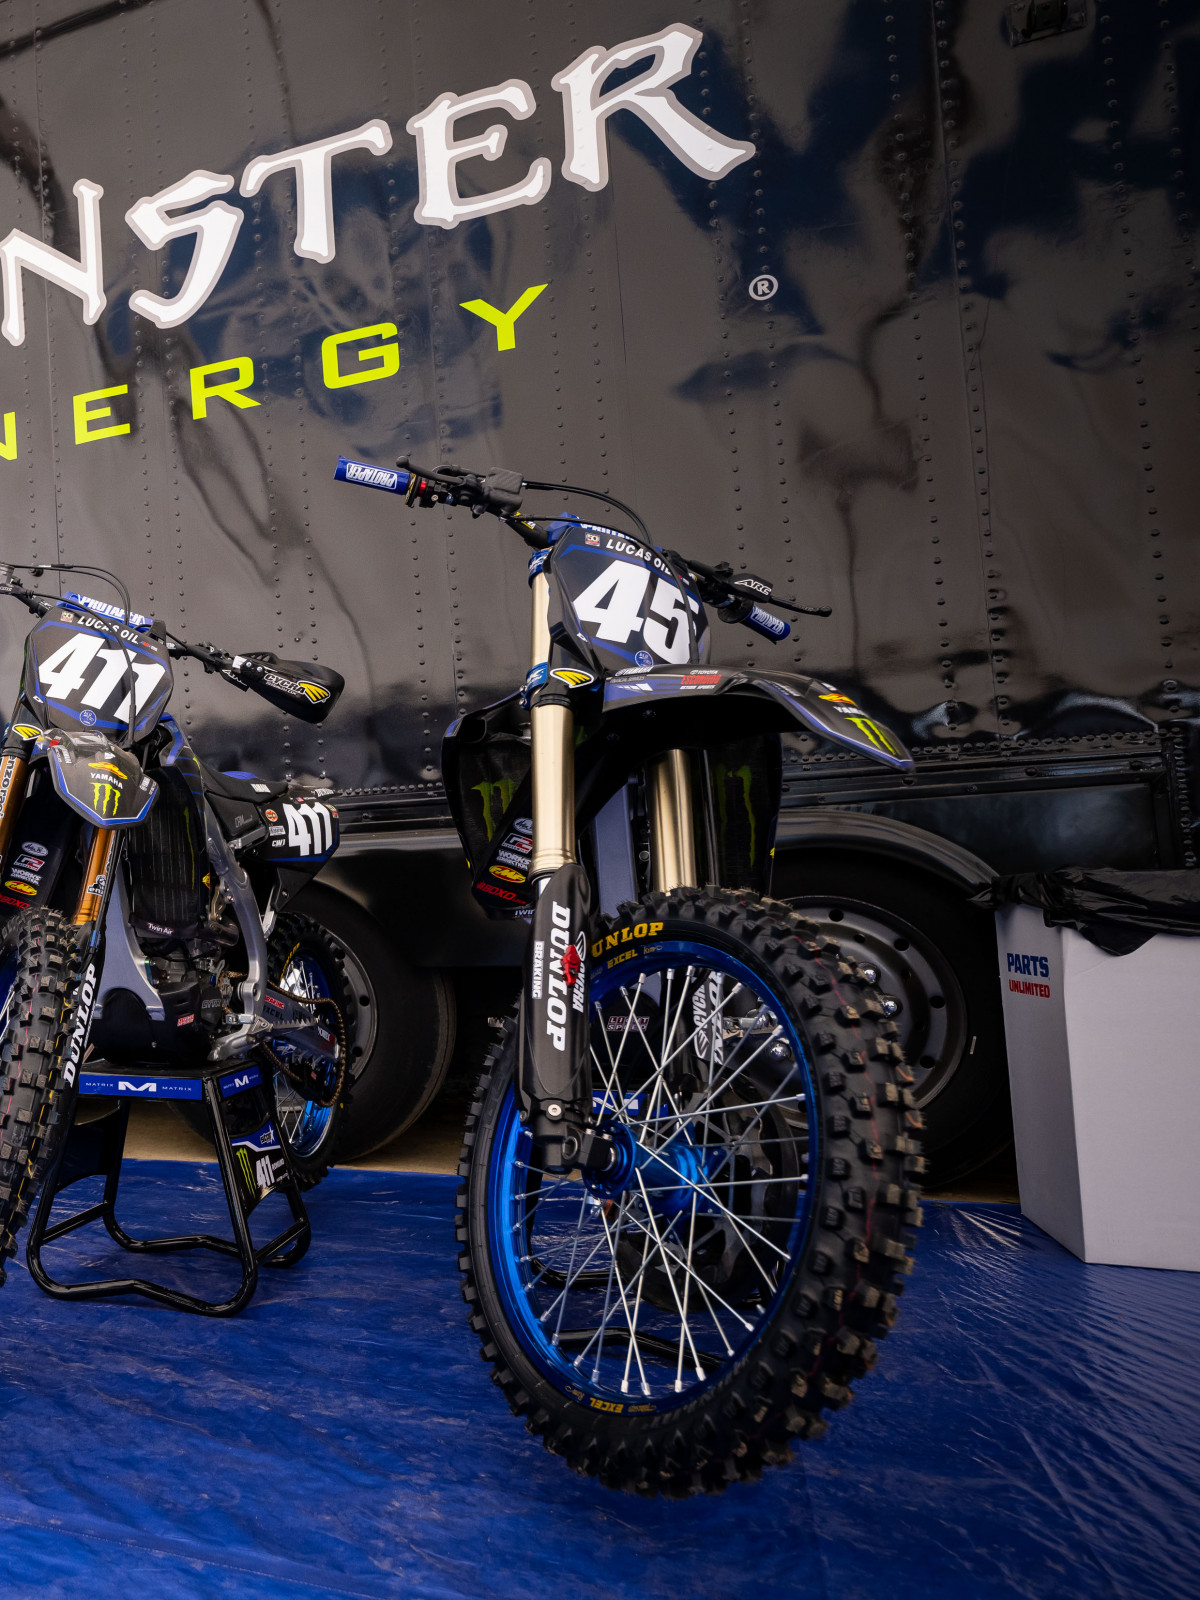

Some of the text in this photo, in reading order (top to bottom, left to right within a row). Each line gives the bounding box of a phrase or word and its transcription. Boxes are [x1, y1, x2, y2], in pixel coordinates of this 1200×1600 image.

[348, 464, 397, 489] PROTAPER
[606, 538, 672, 575] LUCAS OIL
[734, 579, 772, 596] ARC
[573, 559, 700, 665] 45
[753, 606, 785, 635] PROTAPER
[77, 615, 140, 645] LUCAS OIL
[38, 632, 166, 724] 411
[263, 672, 306, 694] CYCRA
[680, 674, 722, 685] ESCONDIDO
[90, 772, 123, 789] YAMAHA
[282, 801, 333, 857] 411
[499, 849, 532, 866] WORKS
[482, 882, 517, 901] BOXO
[147, 922, 174, 936] Twin Air
[592, 921, 664, 958] UNLOP
[531, 940, 545, 1000] BRAKING
[607, 949, 639, 970] EXCEL
[1006, 953, 1050, 978] PARTS
[546, 900, 571, 1052] DUNLOP
[572, 958, 586, 1014] CYCRA
[1008, 979, 1050, 999] UNLIMITED
[263, 1005, 284, 1020] EXCEL
[63, 962, 96, 1089] DUNLOP
[589, 1397, 624, 1414] EXCEL
